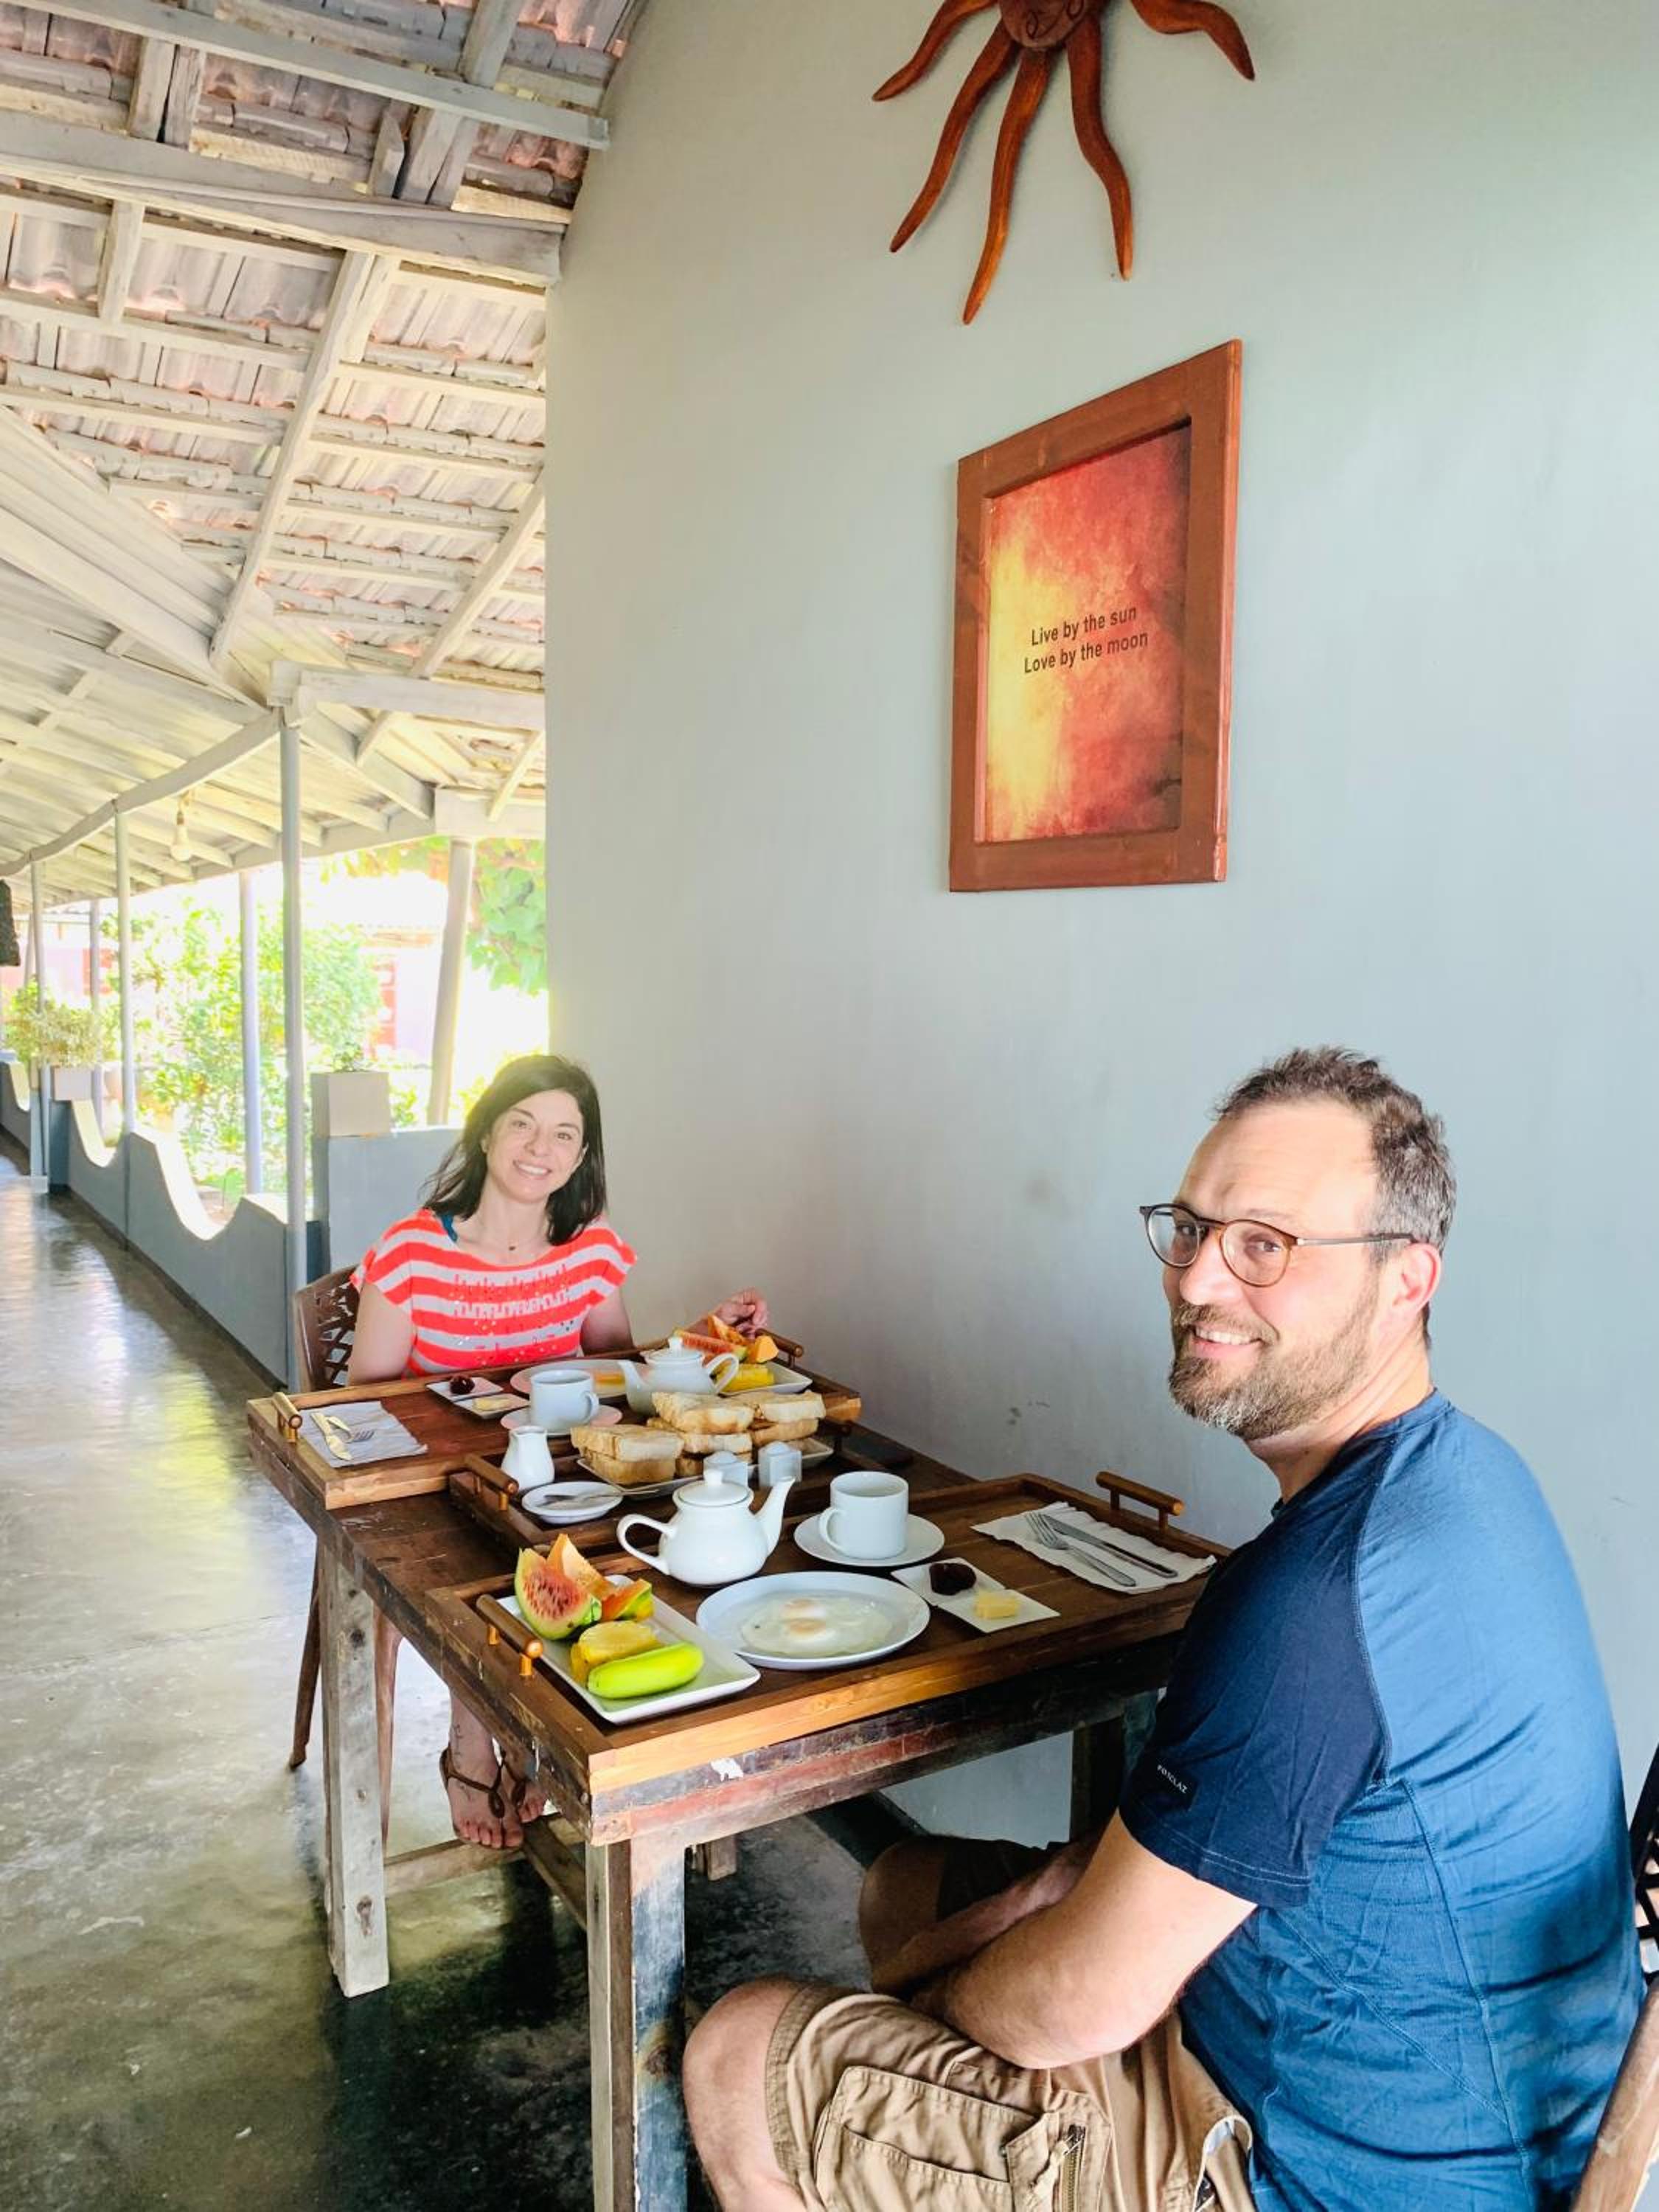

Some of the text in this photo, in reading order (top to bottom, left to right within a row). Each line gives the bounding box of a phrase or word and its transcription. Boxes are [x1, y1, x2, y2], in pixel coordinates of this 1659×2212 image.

[1032, 607, 1136, 646] Live by the sun
[1024, 633, 1148, 673] Love by the moon
